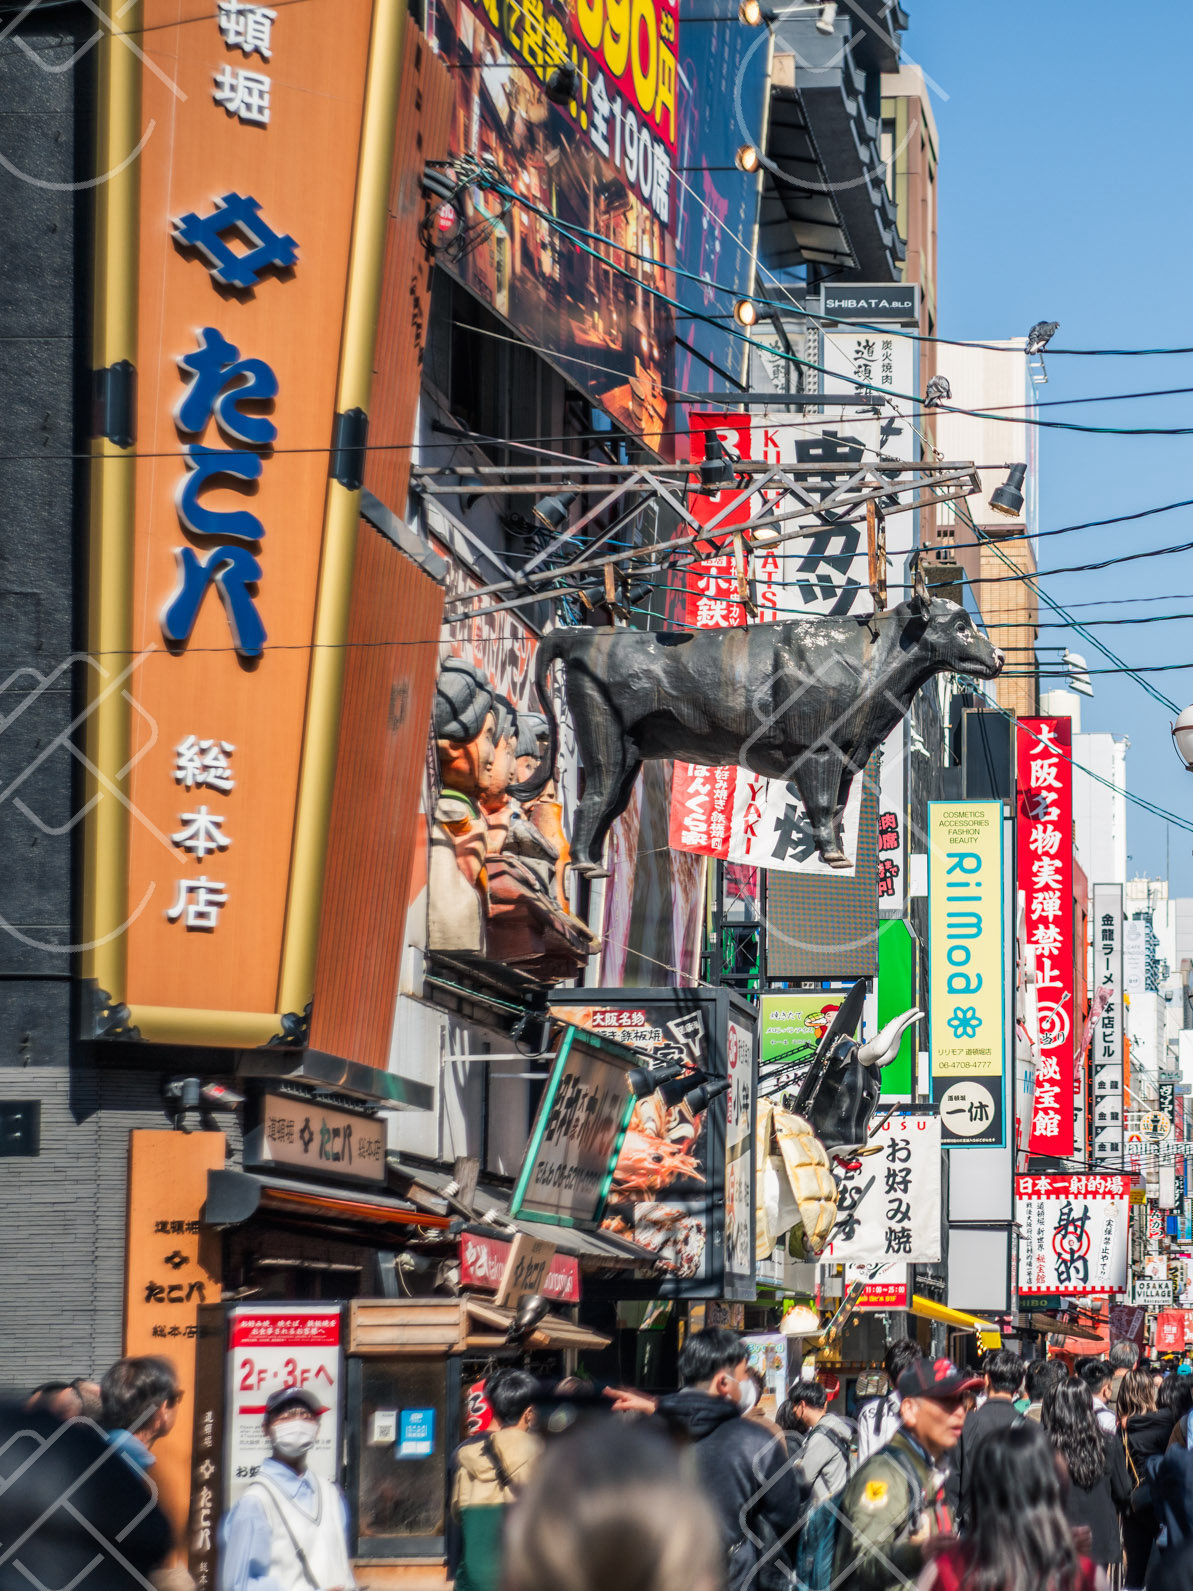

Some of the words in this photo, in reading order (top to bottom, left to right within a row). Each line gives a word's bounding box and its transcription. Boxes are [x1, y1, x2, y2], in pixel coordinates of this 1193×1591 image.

[590, 70, 671, 224] 全190席
[881, 339, 893, 385] 炭火焼肉
[695, 567, 735, 628] 小鉄
[167, 735, 236, 930] 総本店
[1029, 723, 1064, 988] 大阪名物実弾禁止
[1101, 913, 1115, 1058] 金龍ラーメ本店ビル
[593, 1012, 645, 1026] 大阪名物
[938, 1061, 992, 1069] 06-4708-4777
[1033, 1057, 1063, 1137] 秘宝館
[1098, 1081, 1119, 1089] 金龍
[946, 1101, 989, 1122] 一休
[1098, 1111, 1119, 1120] 金龍
[1098, 1143, 1119, 1152] 金龍
[884, 1137, 913, 1254] お好み焼
[1019, 1176, 1123, 1194] 日本一射的場
[1054, 1200, 1091, 1285] 射的
[1137, 1290, 1171, 1298] VILLAGE
[1139, 1282, 1170, 1290] OSAKA
[199, 1561, 209, 1591] 総本
